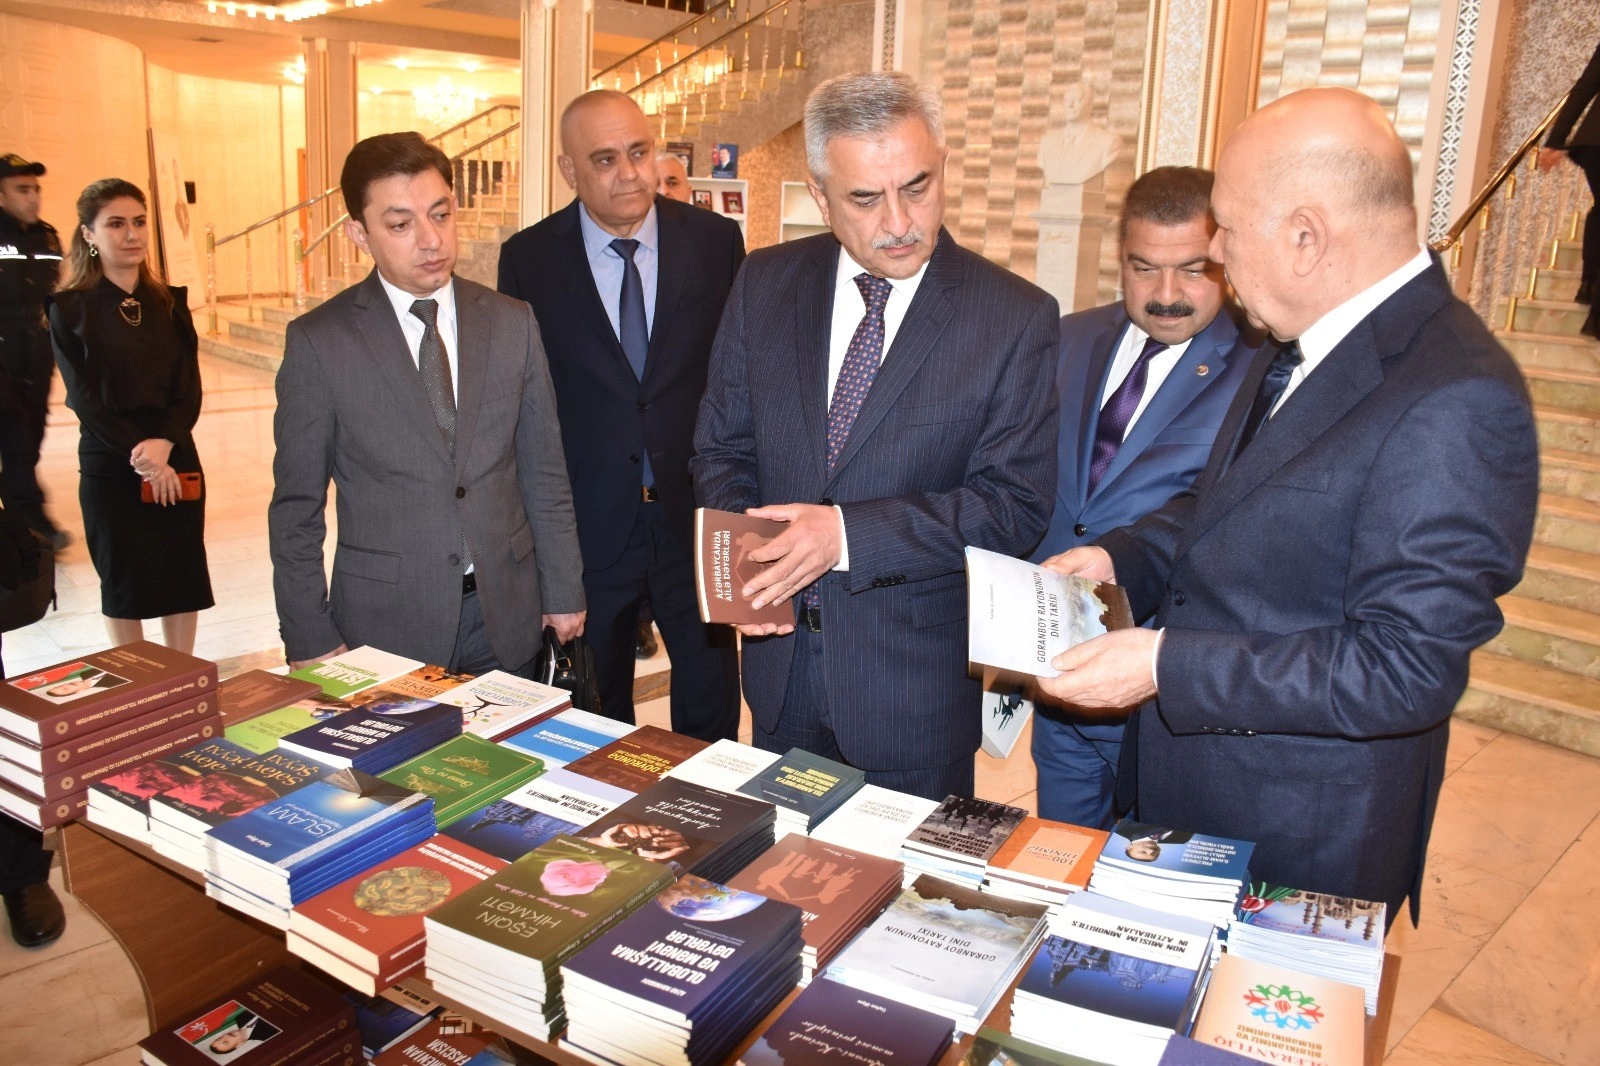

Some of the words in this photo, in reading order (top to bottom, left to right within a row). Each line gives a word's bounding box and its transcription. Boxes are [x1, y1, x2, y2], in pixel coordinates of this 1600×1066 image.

[715, 530, 723, 600] AZƏRBAYCANDA
[722, 530, 732, 581] DƏYƏRLƏRİ
[722, 581, 733, 602] AİLƏ
[1032, 571, 1046, 614] RAYONUNUN
[1047, 592, 1059, 617] TARİXİ
[1036, 614, 1047, 663] GORANBOY
[1049, 618, 1059, 637] DİNİ
[180, 750, 228, 772] əfəvi
[605, 752, 660, 773] DÖVRÜNDƏ
[268, 802, 336, 836] İSLAM
[1051, 856, 1074, 864] 100
[480, 896, 562, 929] HİKMƏTİ
[475, 911, 538, 939] EŞQİN
[919, 926, 946, 942] TARİXİ
[1071, 920, 1121, 940] MINORITIES
[1116, 925, 1175, 944] AZERBAIJAN
[665, 929, 736, 959] DƏYƏRLƏR
[884, 925, 941, 949] RAYONUNUN
[948, 935, 971, 947] DİNİ
[1126, 935, 1163, 950] MUSLIM
[1166, 942, 1186, 954] NON
[1178, 939, 1189, 947] IN
[646, 940, 703, 967] MƏNƏVİ
[943, 944, 997, 962] GORANBOY
[611, 944, 706, 985] QLOBALLAŞMA
[700, 957, 721, 973] VƏ
[426, 1038, 472, 1066] FASCISM
